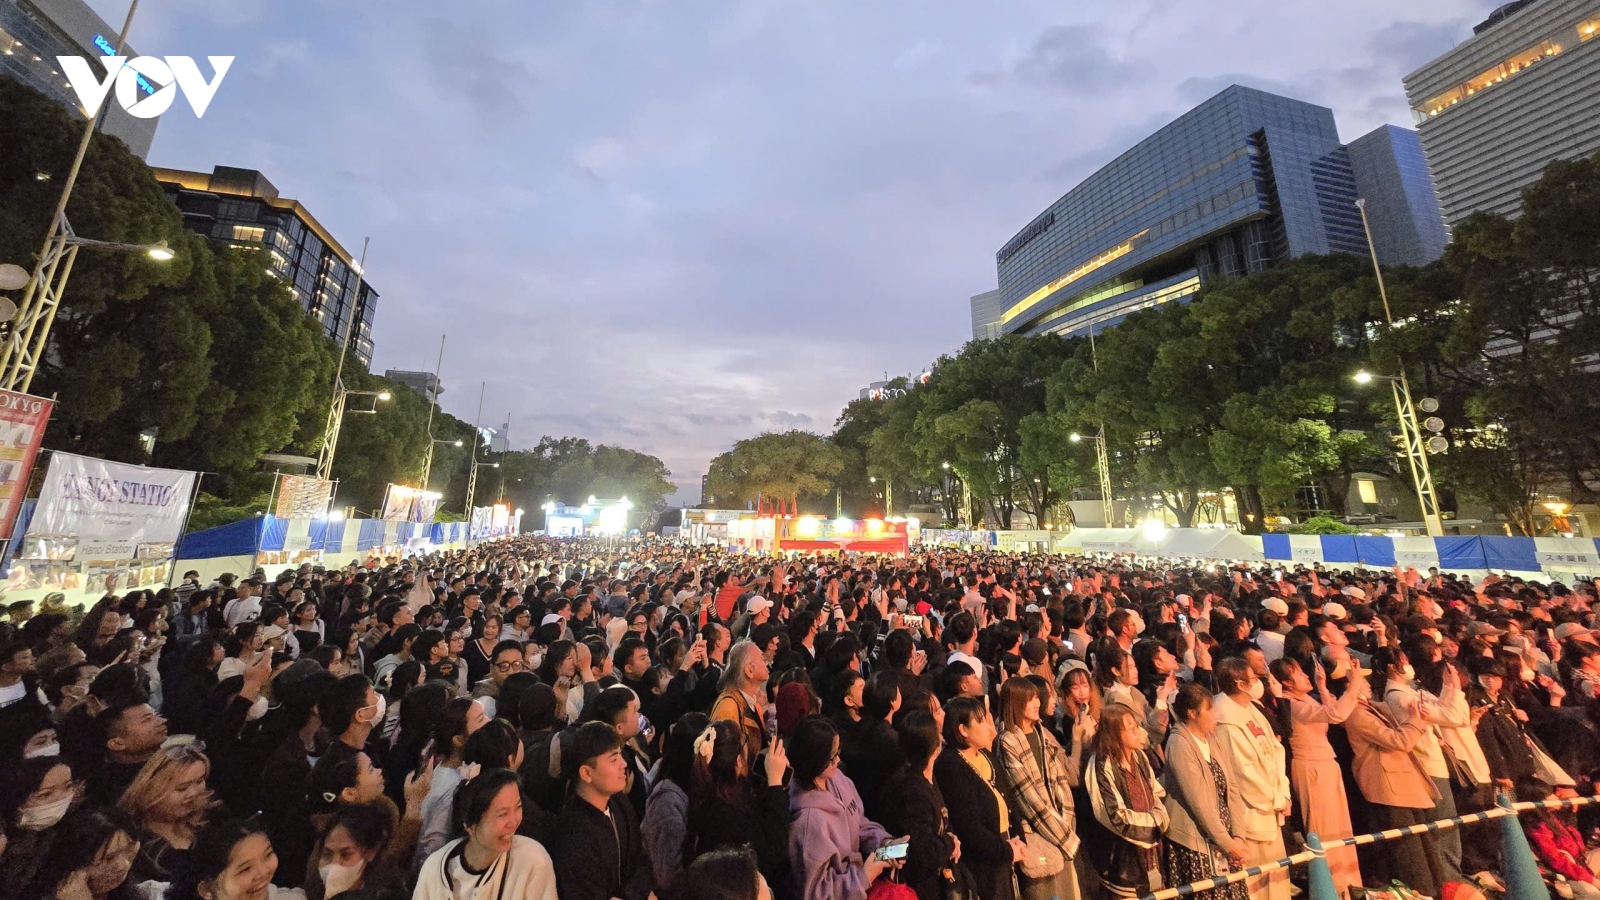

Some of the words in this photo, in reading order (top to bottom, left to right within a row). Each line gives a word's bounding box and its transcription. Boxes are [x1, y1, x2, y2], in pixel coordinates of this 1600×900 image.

[118, 480, 178, 507] STATIO
[81, 544, 105, 555] Hanoi
[105, 544, 132, 554] Station
